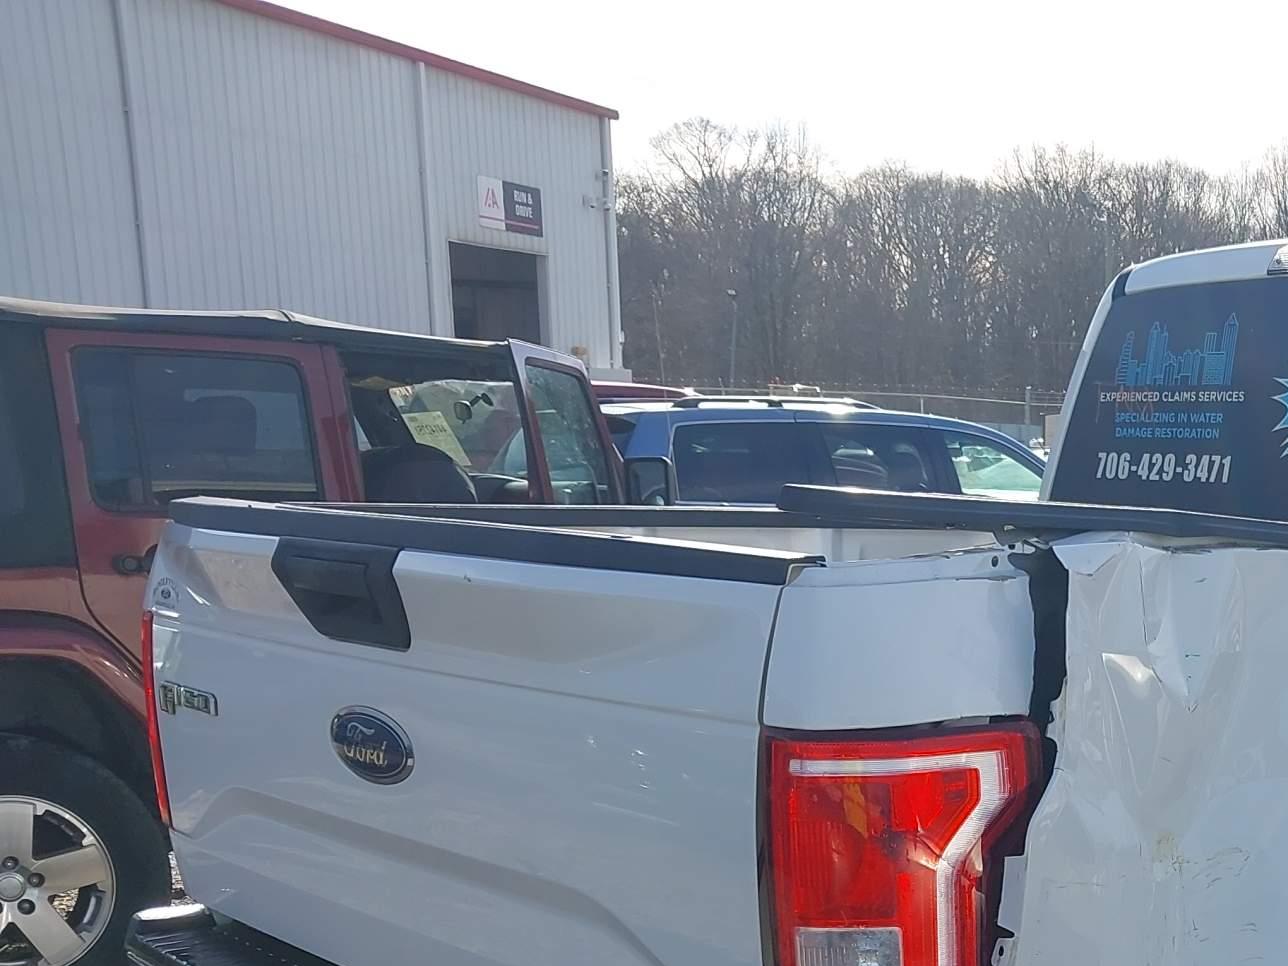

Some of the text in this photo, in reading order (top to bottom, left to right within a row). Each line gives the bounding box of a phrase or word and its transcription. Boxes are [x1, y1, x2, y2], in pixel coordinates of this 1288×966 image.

[513, 189, 533, 205] RUN &
[515, 204, 533, 219] DRIVE
[1099, 391, 1245, 402] EXPERIENCED CLAIMS SERVICES
[1115, 412, 1224, 424] SPECIALIZING IN WATER
[1115, 427, 1220, 439] DAMAGE RESTORATION
[1096, 451, 1232, 484] 706-429-3471
[343, 721, 389, 768] Ford
